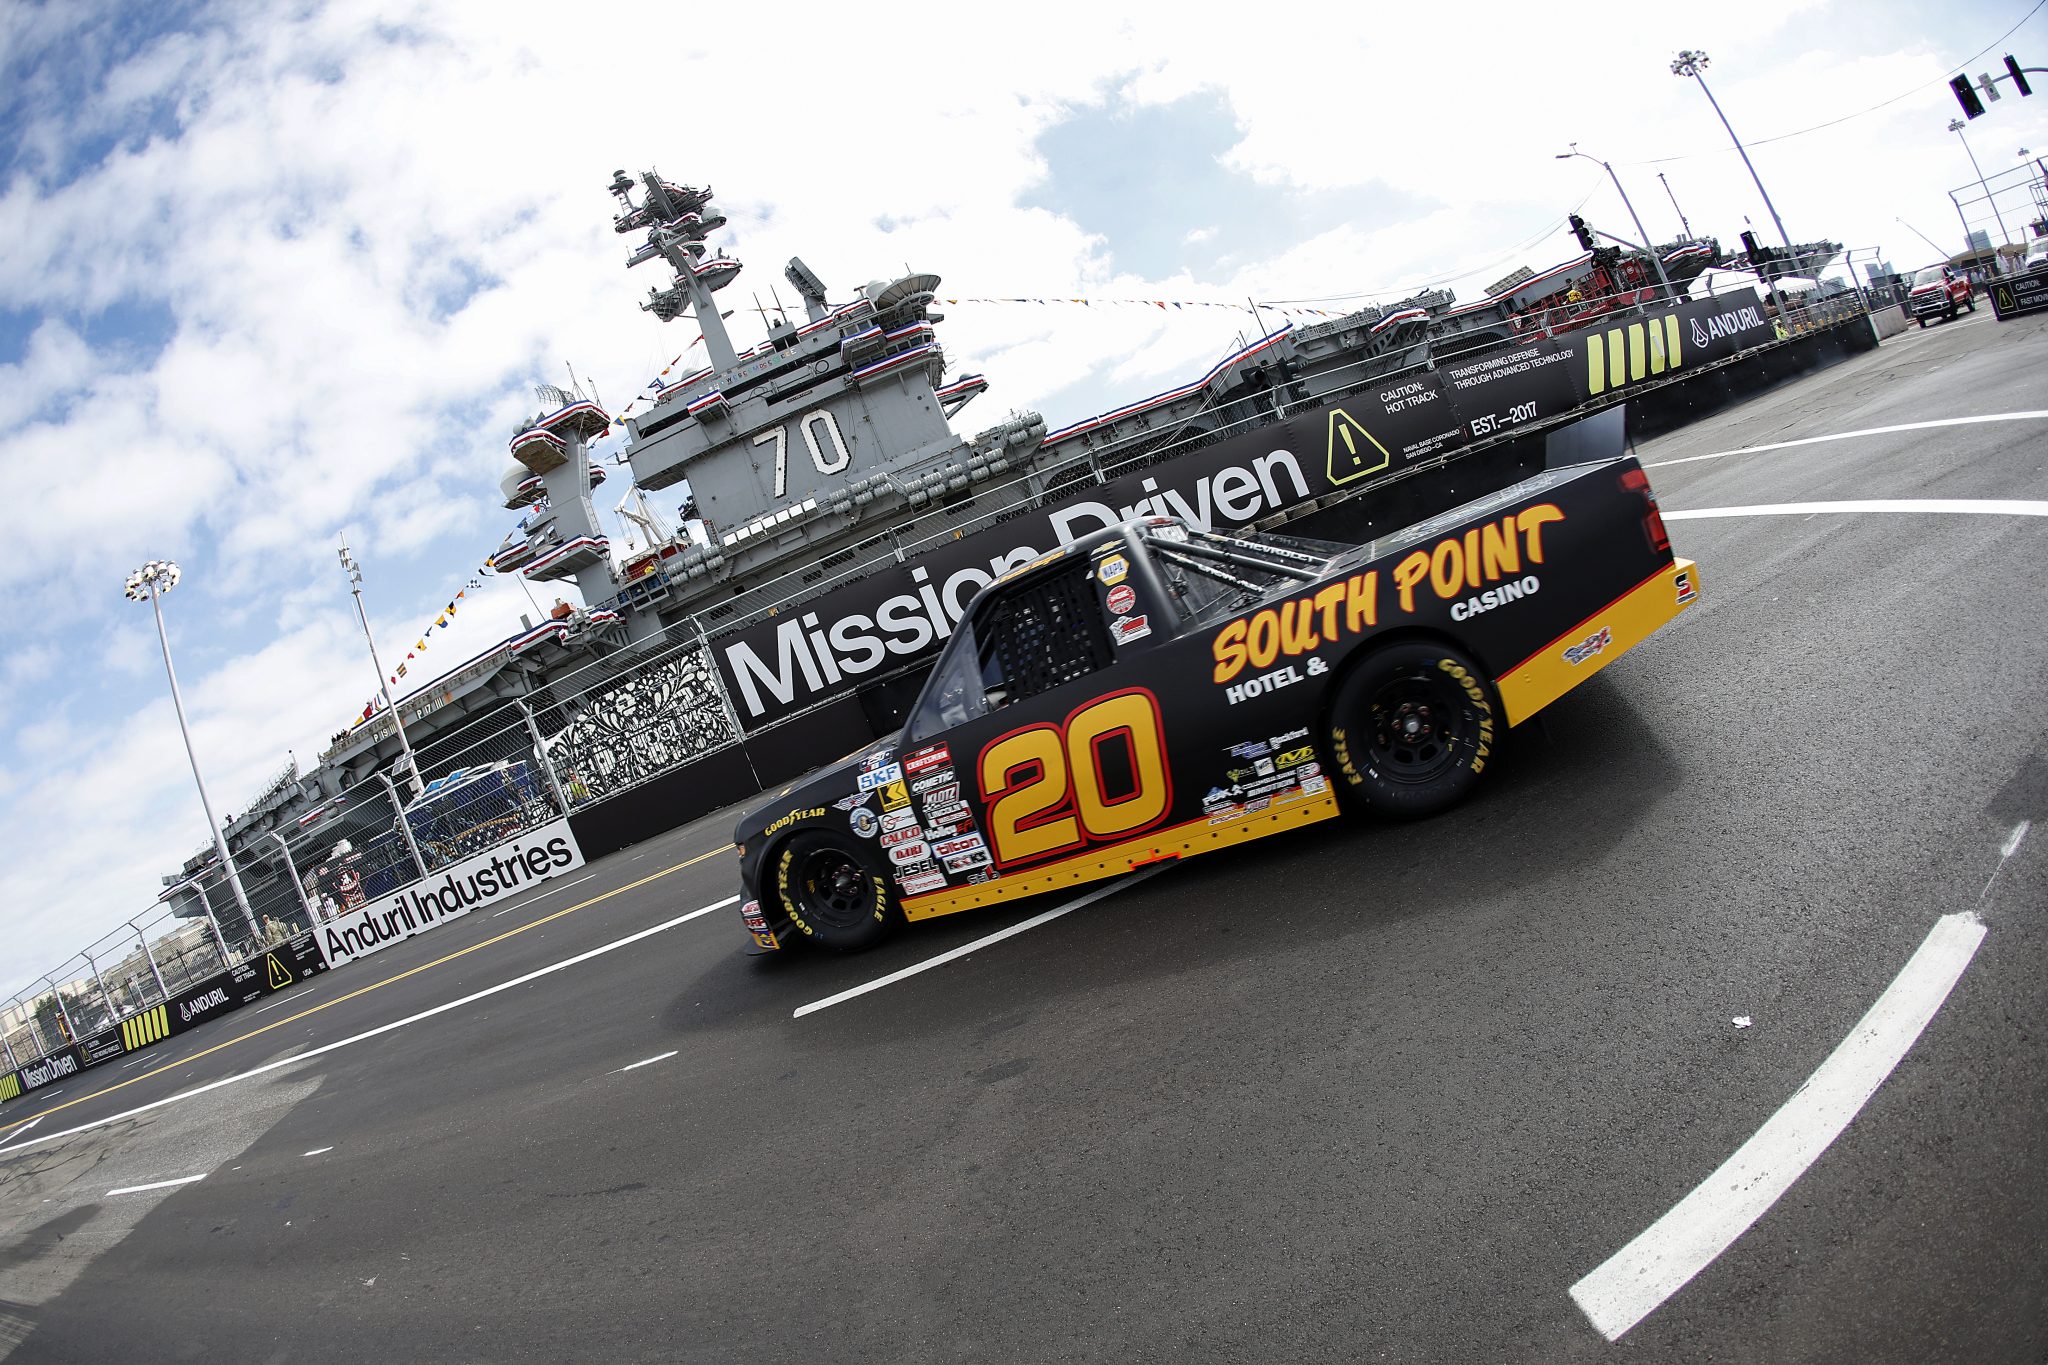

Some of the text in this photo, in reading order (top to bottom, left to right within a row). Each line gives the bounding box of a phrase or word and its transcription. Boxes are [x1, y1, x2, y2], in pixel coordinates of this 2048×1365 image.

[1707, 306, 1765, 340] ANDURIL
[1449, 348, 1540, 380] TRANSFORMING DEFENSE
[1454, 349, 1574, 390] THROUGH ADVANCED TECHNOLOGY
[1380, 382, 1425, 403] CAUTION:
[1385, 389, 1439, 415] HOT TRACK
[1419, 439, 1433, 448] BASE
[1432, 428, 1460, 443] CORONADO
[752, 409, 852, 499] 70
[1405, 452, 1417, 460] SAN
[1234, 539, 1315, 562] CHEVROLET
[1212, 503, 1566, 685] SOUTH POINT
[1450, 575, 1540, 623] CASINO
[1225, 656, 1331, 705] HOTEL &
[1332, 726, 1363, 786] EAGLE
[860, 765, 898, 790] SKF
[911, 770, 954, 792] COMETIC
[976, 687, 1173, 869] 20
[926, 787, 956, 803] KLOTZ
[764, 807, 826, 836] GOODYEAR
[928, 803, 961, 819] LINCOLN
[882, 826, 922, 847] CALICO
[924, 825, 958, 842] Holley
[936, 837, 980, 855] tilton
[895, 843, 924, 860] DART
[894, 859, 938, 879] JESEL
[325, 893, 418, 963] Anduril
[410, 837, 573, 925] Industries
[872, 876, 887, 923] EAGLE
[302, 967, 314, 977] USA
[189, 987, 230, 1017] ANDURIL
[21, 1054, 78, 1090] Mission Driven
